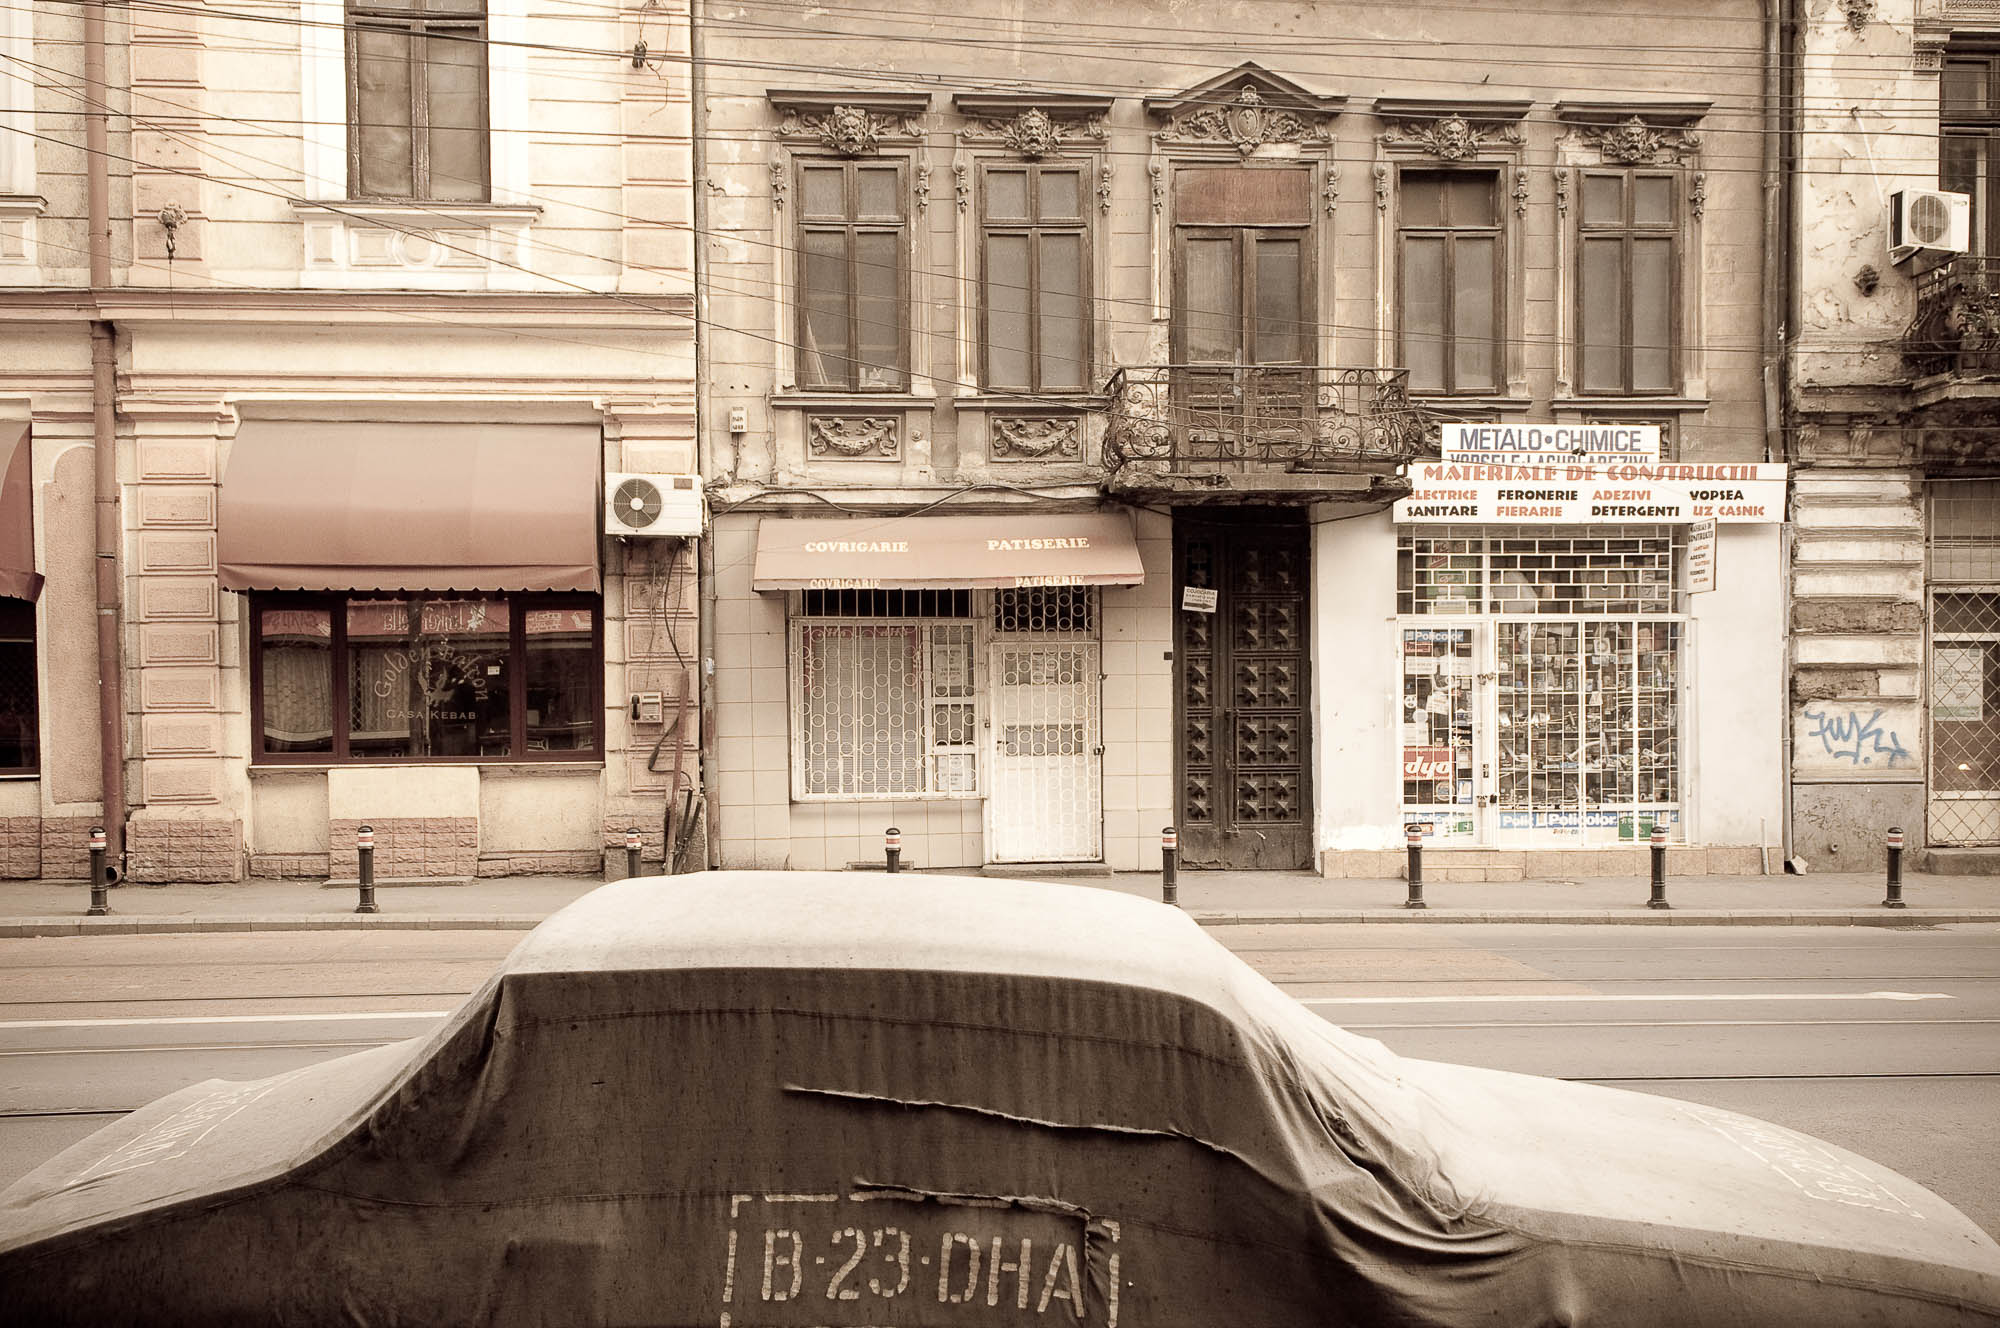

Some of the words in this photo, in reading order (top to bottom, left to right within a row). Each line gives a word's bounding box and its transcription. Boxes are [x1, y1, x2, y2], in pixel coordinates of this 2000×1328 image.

[1423, 465, 1558, 481] MATERIALE
[1566, 465, 1598, 481] DE
[1607, 465, 1758, 481] CONSTRUCTII
[1497, 489, 1578, 501] FERONERIE
[1592, 489, 1651, 501] ADEZIVI
[1689, 489, 1744, 501] VOPSEA
[1407, 505, 1478, 517] SANITARE
[1496, 505, 1562, 517] FIERARIE
[1591, 505, 1680, 517] DETERGENTI
[1692, 505, 1714, 516] UZ
[1718, 505, 1765, 516] CASNIC
[804, 541, 909, 553] COVRIGARIE
[987, 537, 1090, 551] PATISERIE
[810, 578, 881, 589] COVRIGARIE
[1014, 575, 1085, 586] PATISERIE
[374, 647, 431, 697] Golden
[386, 709, 425, 719] CASA
[430, 710, 476, 720] KEBAB
